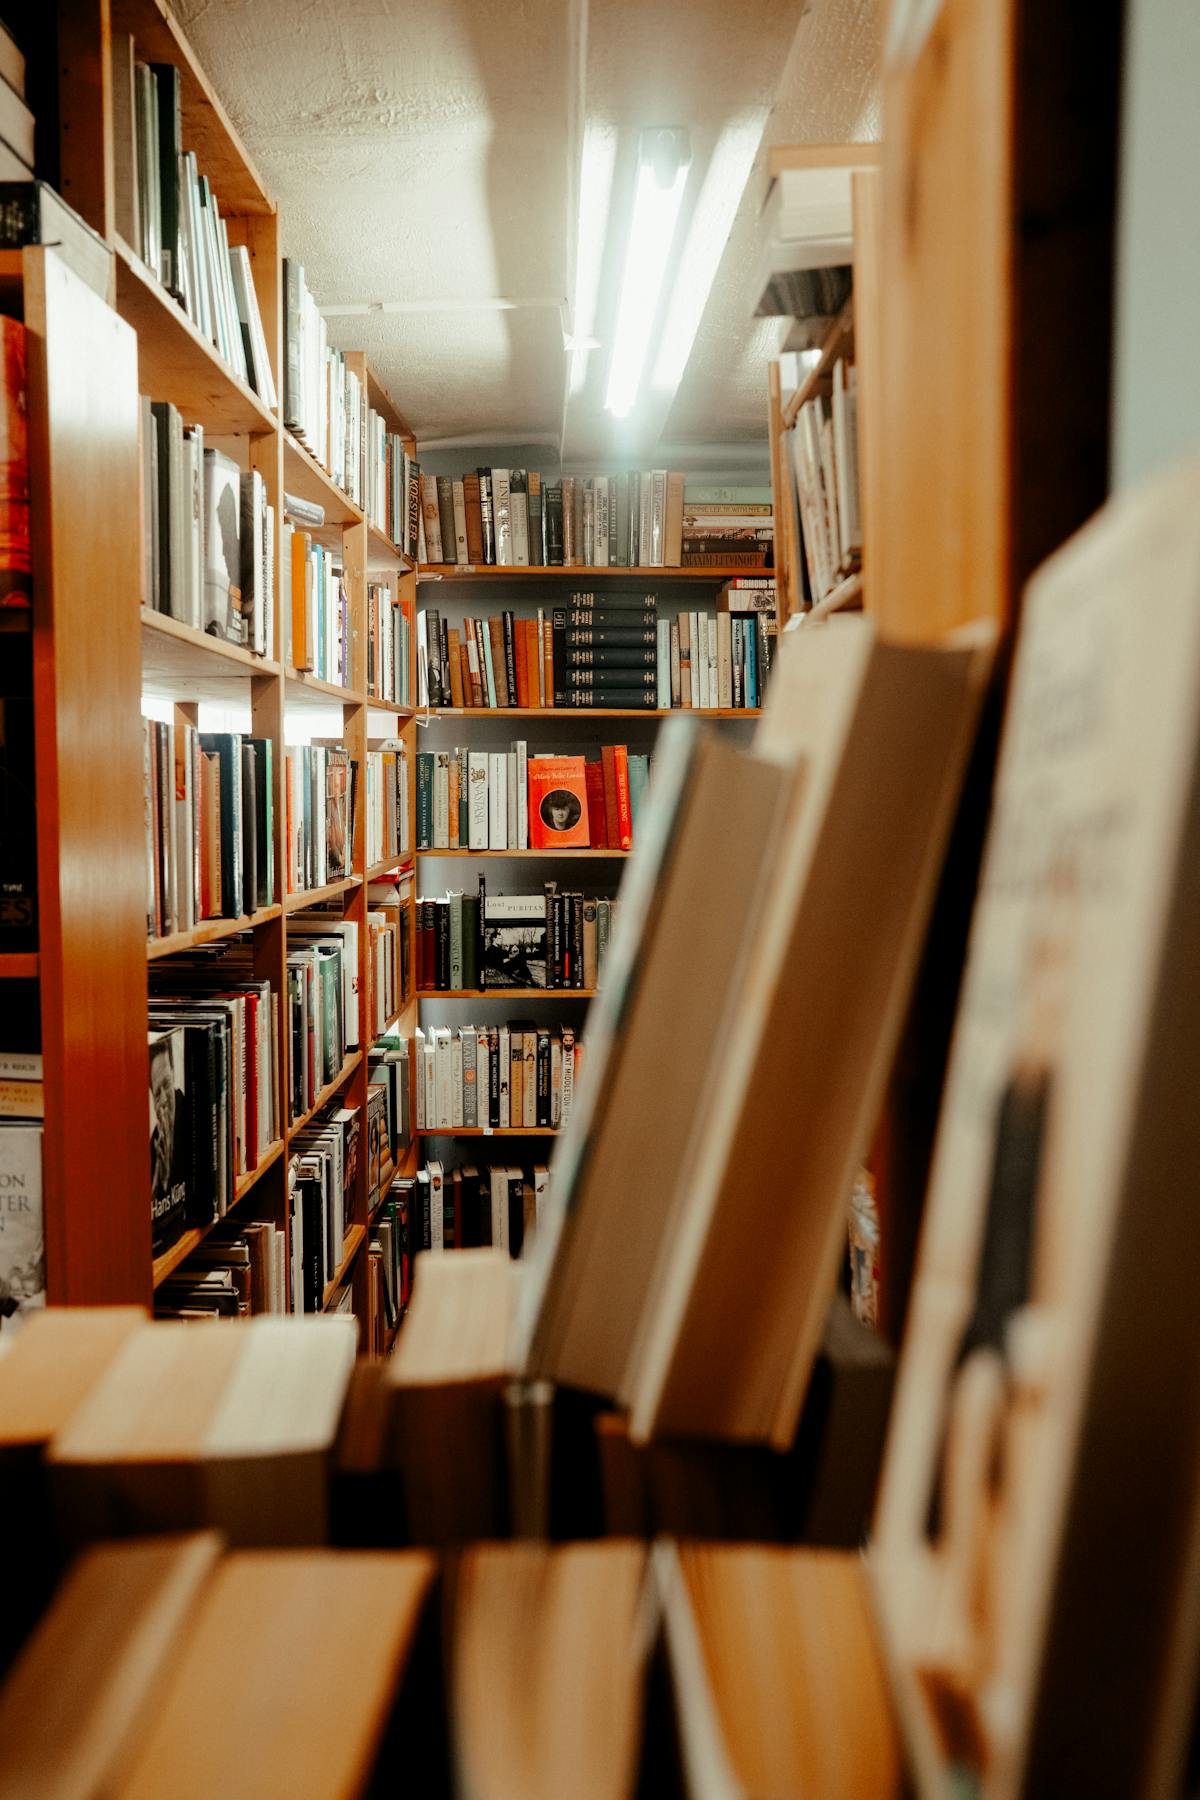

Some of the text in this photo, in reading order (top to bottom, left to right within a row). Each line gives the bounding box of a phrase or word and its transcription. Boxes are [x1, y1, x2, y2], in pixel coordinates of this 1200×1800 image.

[409, 478, 420, 541] KOESTLER
[499, 480, 511, 537] LINDBRGH
[620, 803, 628, 823] KING
[486, 900, 505, 908] Lost
[463, 1041, 472, 1070] MARR
[563, 1053, 572, 1106] ANT MIDDLETON
[463, 1085, 472, 1114] QUEEN
[151, 1195, 171, 1220] Hans
